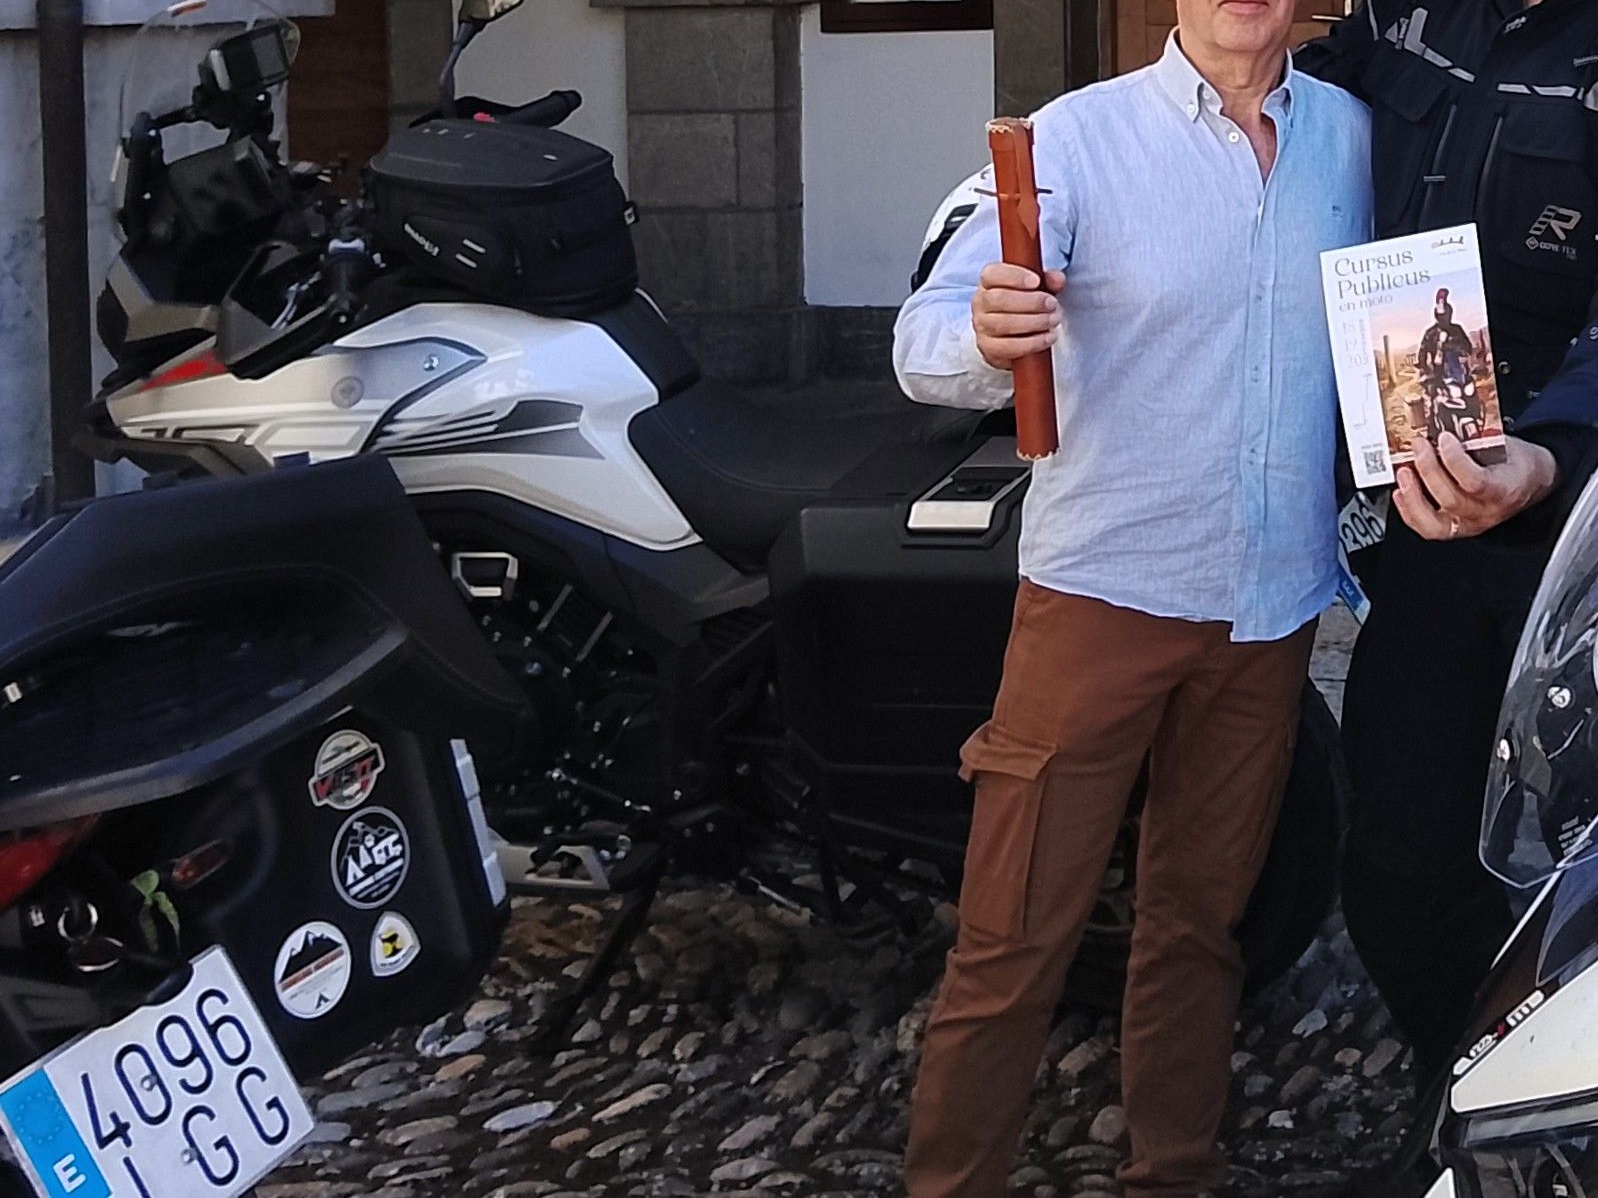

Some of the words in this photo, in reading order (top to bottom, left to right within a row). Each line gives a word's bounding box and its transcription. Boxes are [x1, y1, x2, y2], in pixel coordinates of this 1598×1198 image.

[1335, 250, 1413, 276] Cursus
[1338, 269, 1430, 299] Publicus
[1339, 300, 1355, 312] en
[1359, 294, 1393, 309] moto
[82, 988, 251, 1150] 4096
[53, 1154, 86, 1193] E
